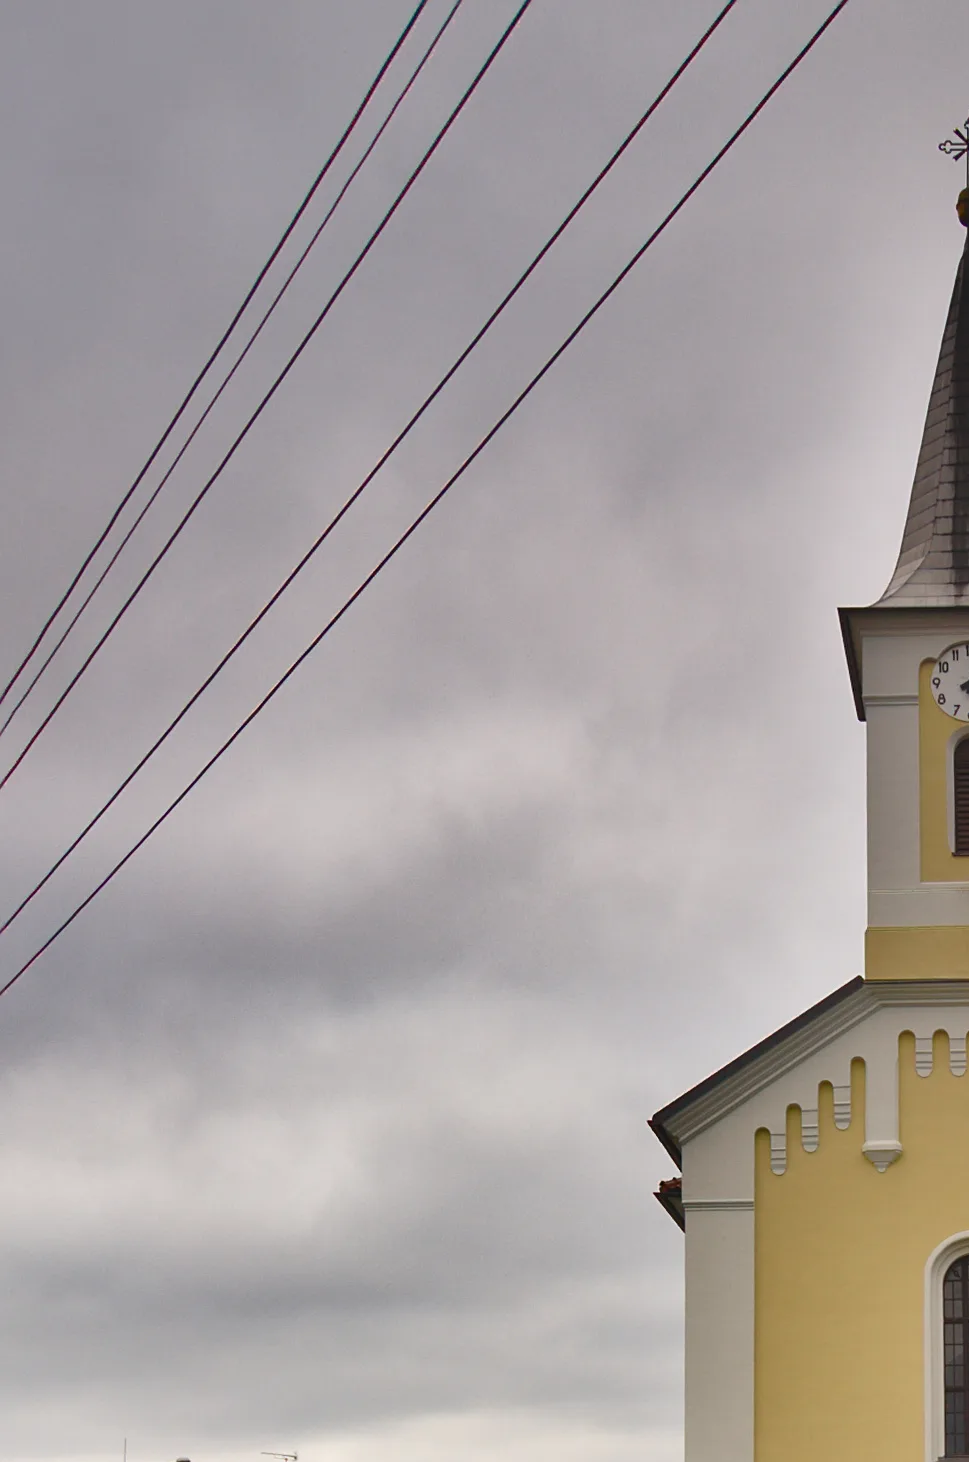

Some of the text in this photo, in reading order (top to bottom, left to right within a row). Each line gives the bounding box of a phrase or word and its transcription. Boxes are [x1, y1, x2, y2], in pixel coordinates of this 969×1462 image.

[952, 650, 958, 661] 11
[939, 662, 948, 673] 10
[932, 678, 940, 689] 9
[938, 694, 946, 705] 8
[954, 705, 960, 716] 7
